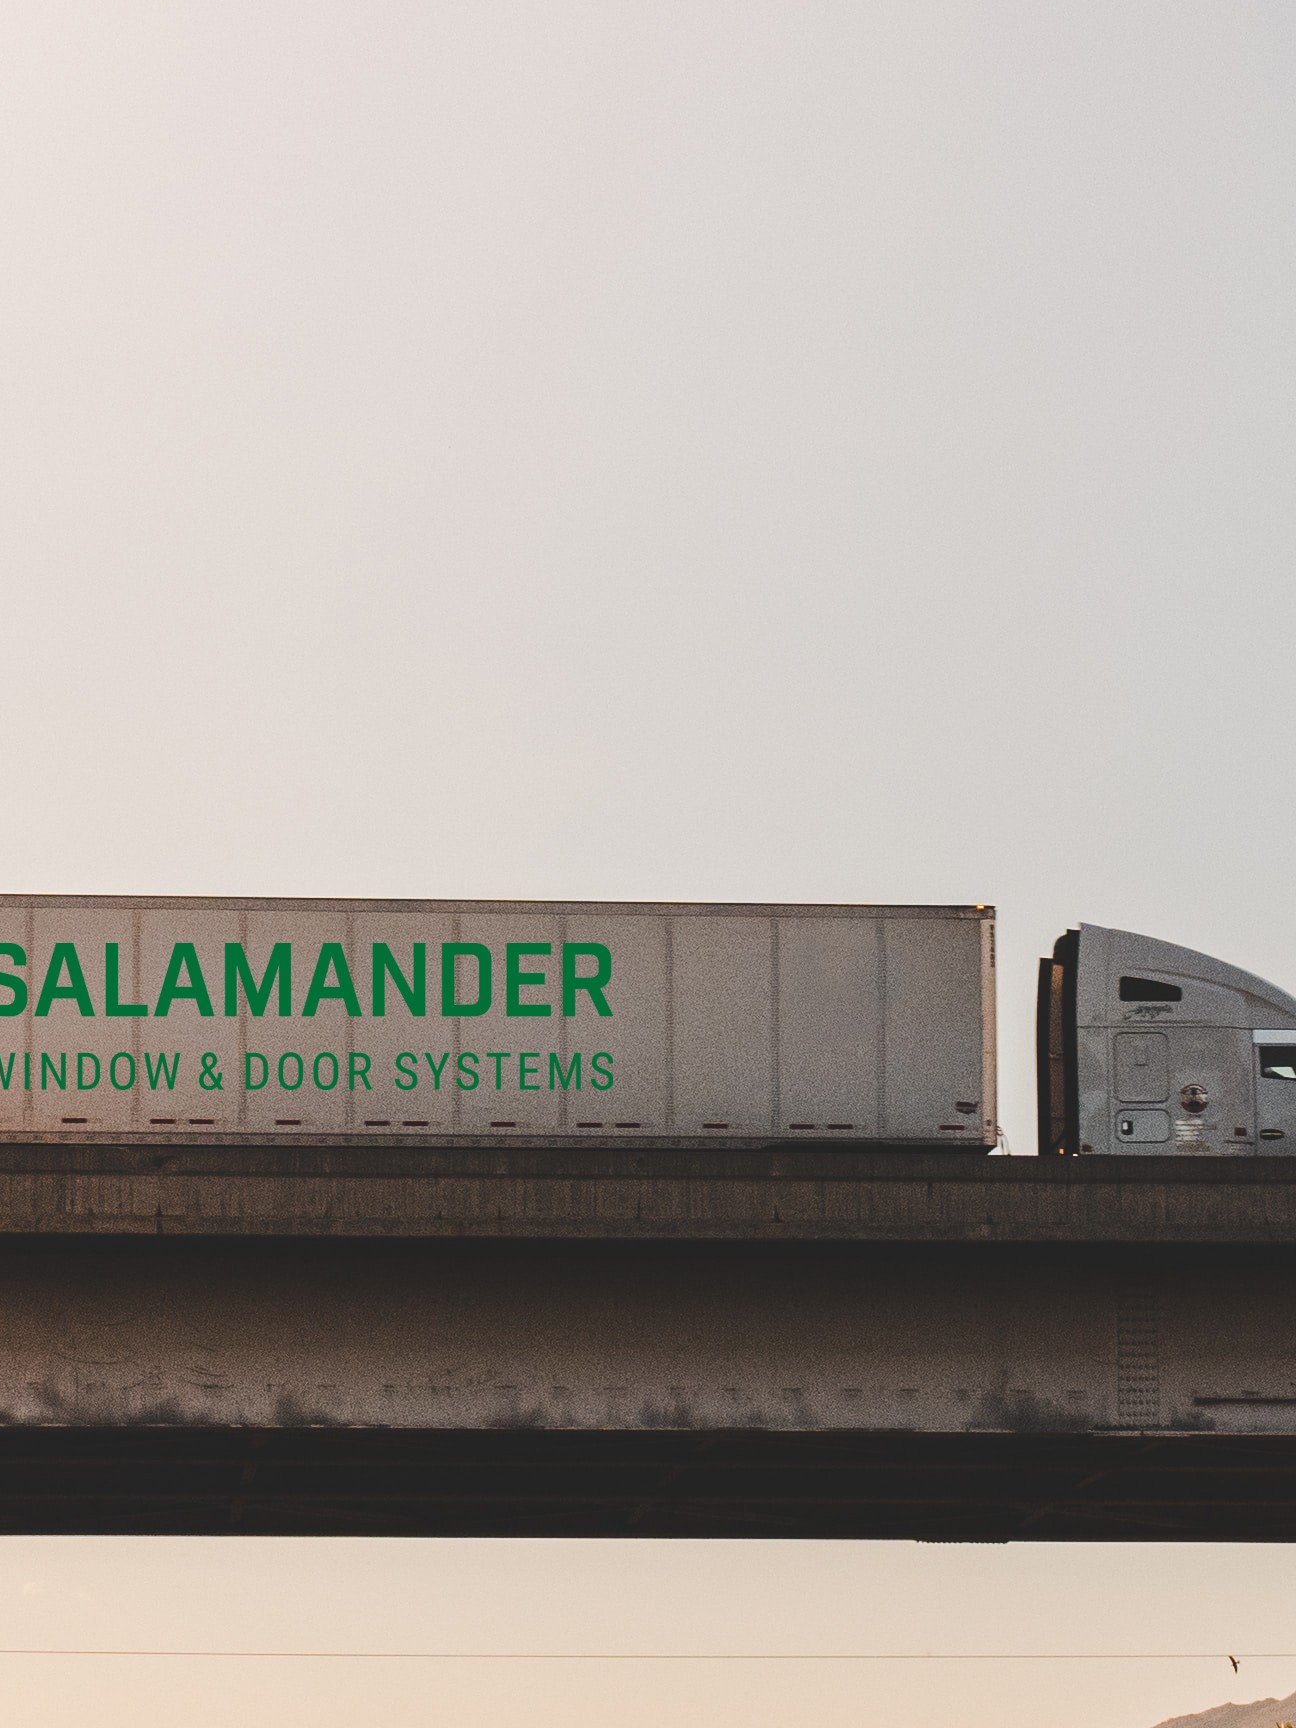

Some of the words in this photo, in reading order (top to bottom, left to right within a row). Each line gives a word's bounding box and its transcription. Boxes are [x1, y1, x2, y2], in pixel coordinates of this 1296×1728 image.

[198, 1051, 224, 1091] &
[245, 1051, 373, 1091] DOOR
[394, 1051, 614, 1091] SYSTEMS
